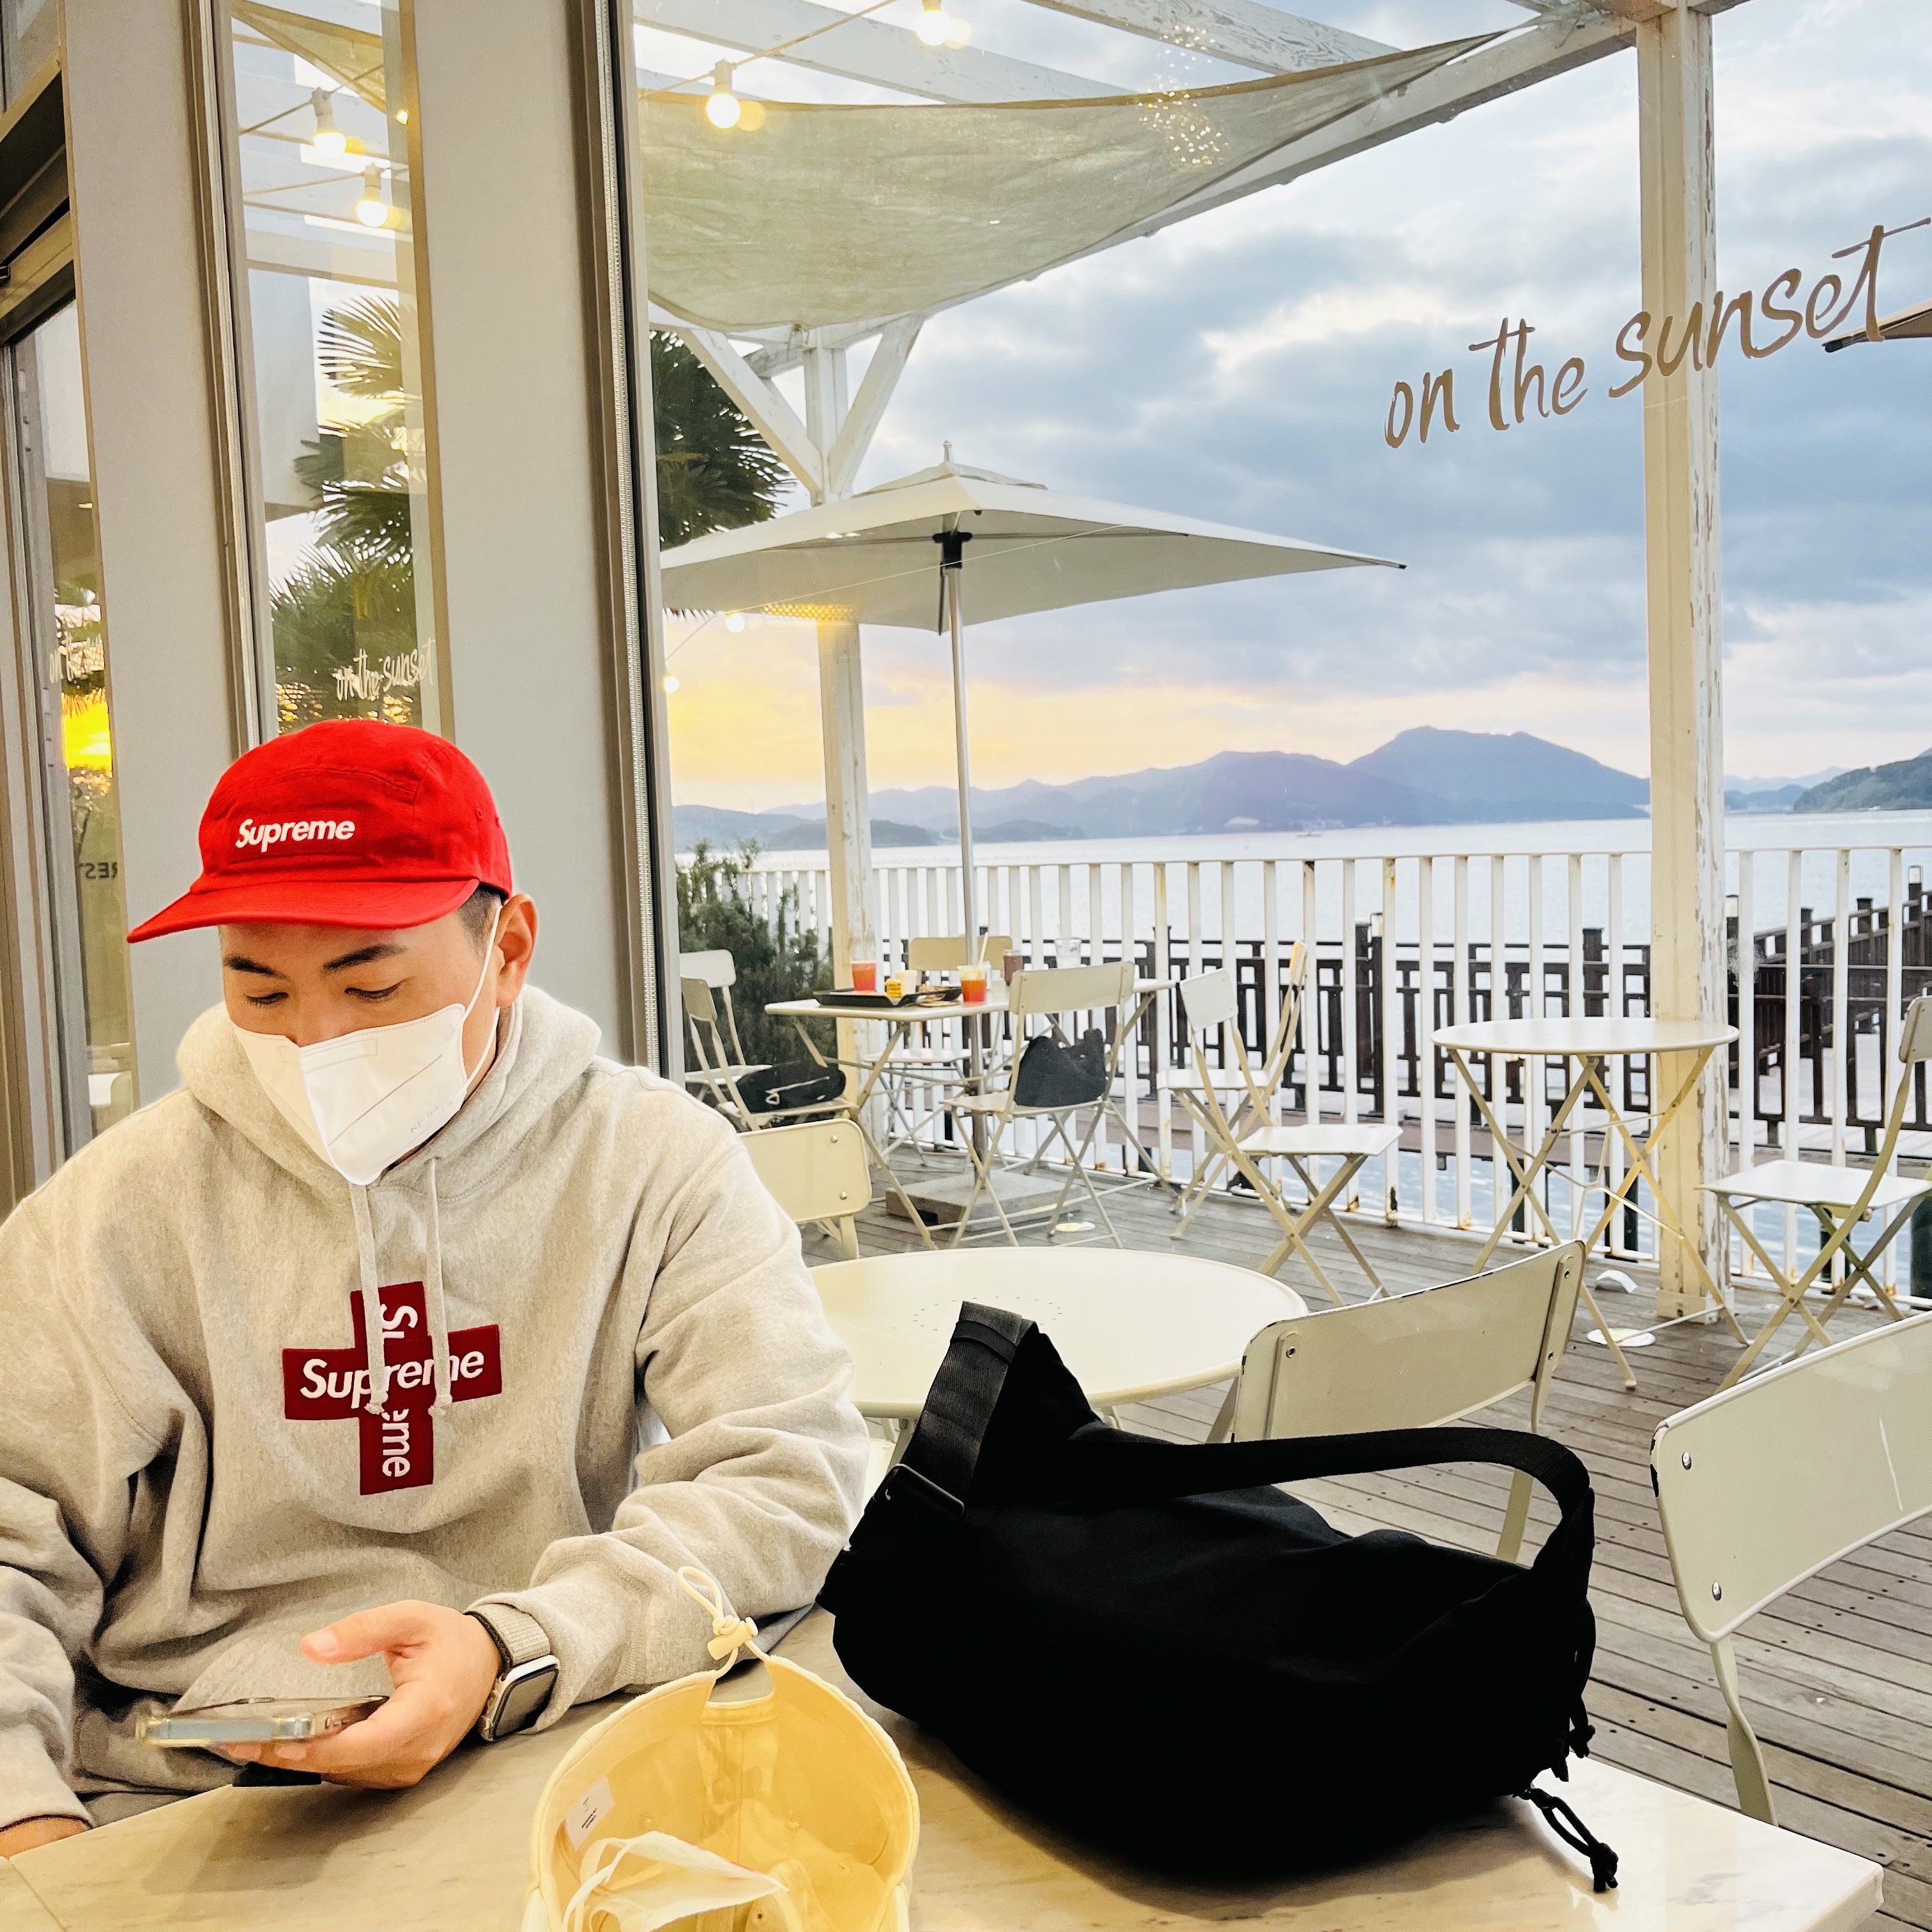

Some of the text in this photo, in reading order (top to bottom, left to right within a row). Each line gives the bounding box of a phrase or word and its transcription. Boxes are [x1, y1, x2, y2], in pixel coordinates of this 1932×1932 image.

[1384, 217, 1931, 448] on the sunset
[383, 637, 436, 693] sunset
[235, 818, 356, 853] Supreme
